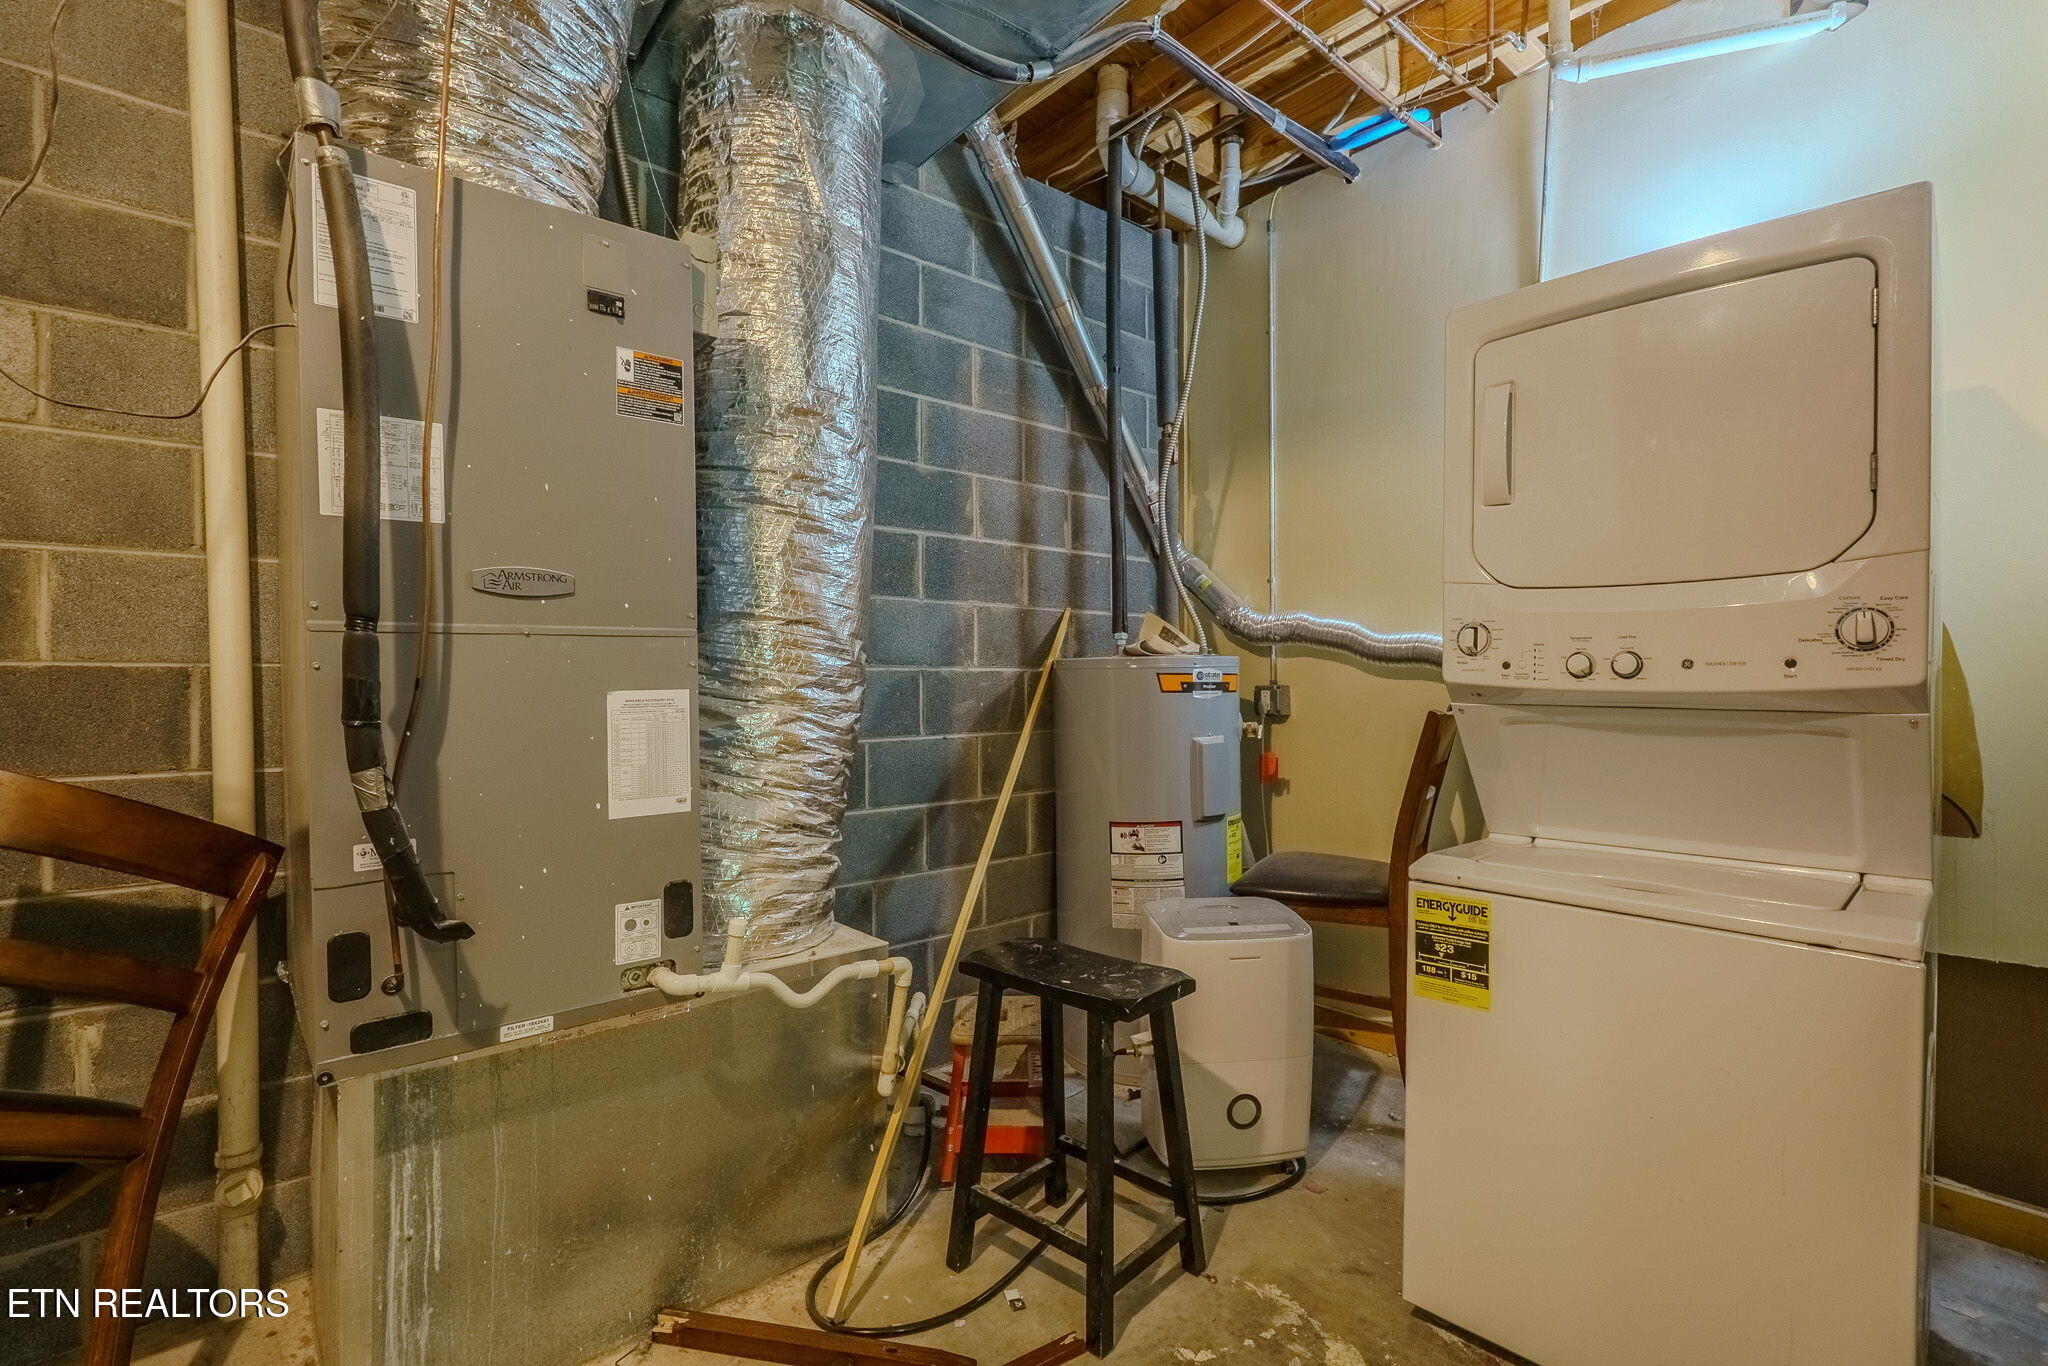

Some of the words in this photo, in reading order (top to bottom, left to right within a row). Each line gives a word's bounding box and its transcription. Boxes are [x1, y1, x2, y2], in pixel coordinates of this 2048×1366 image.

[497, 569, 568, 584] ARMSTRONG
[502, 580, 522, 591] AIR
[1416, 897, 1488, 918] ENERGYGUIDE
[1434, 943, 1455, 954] $23
[1460, 971, 1477, 981] $15
